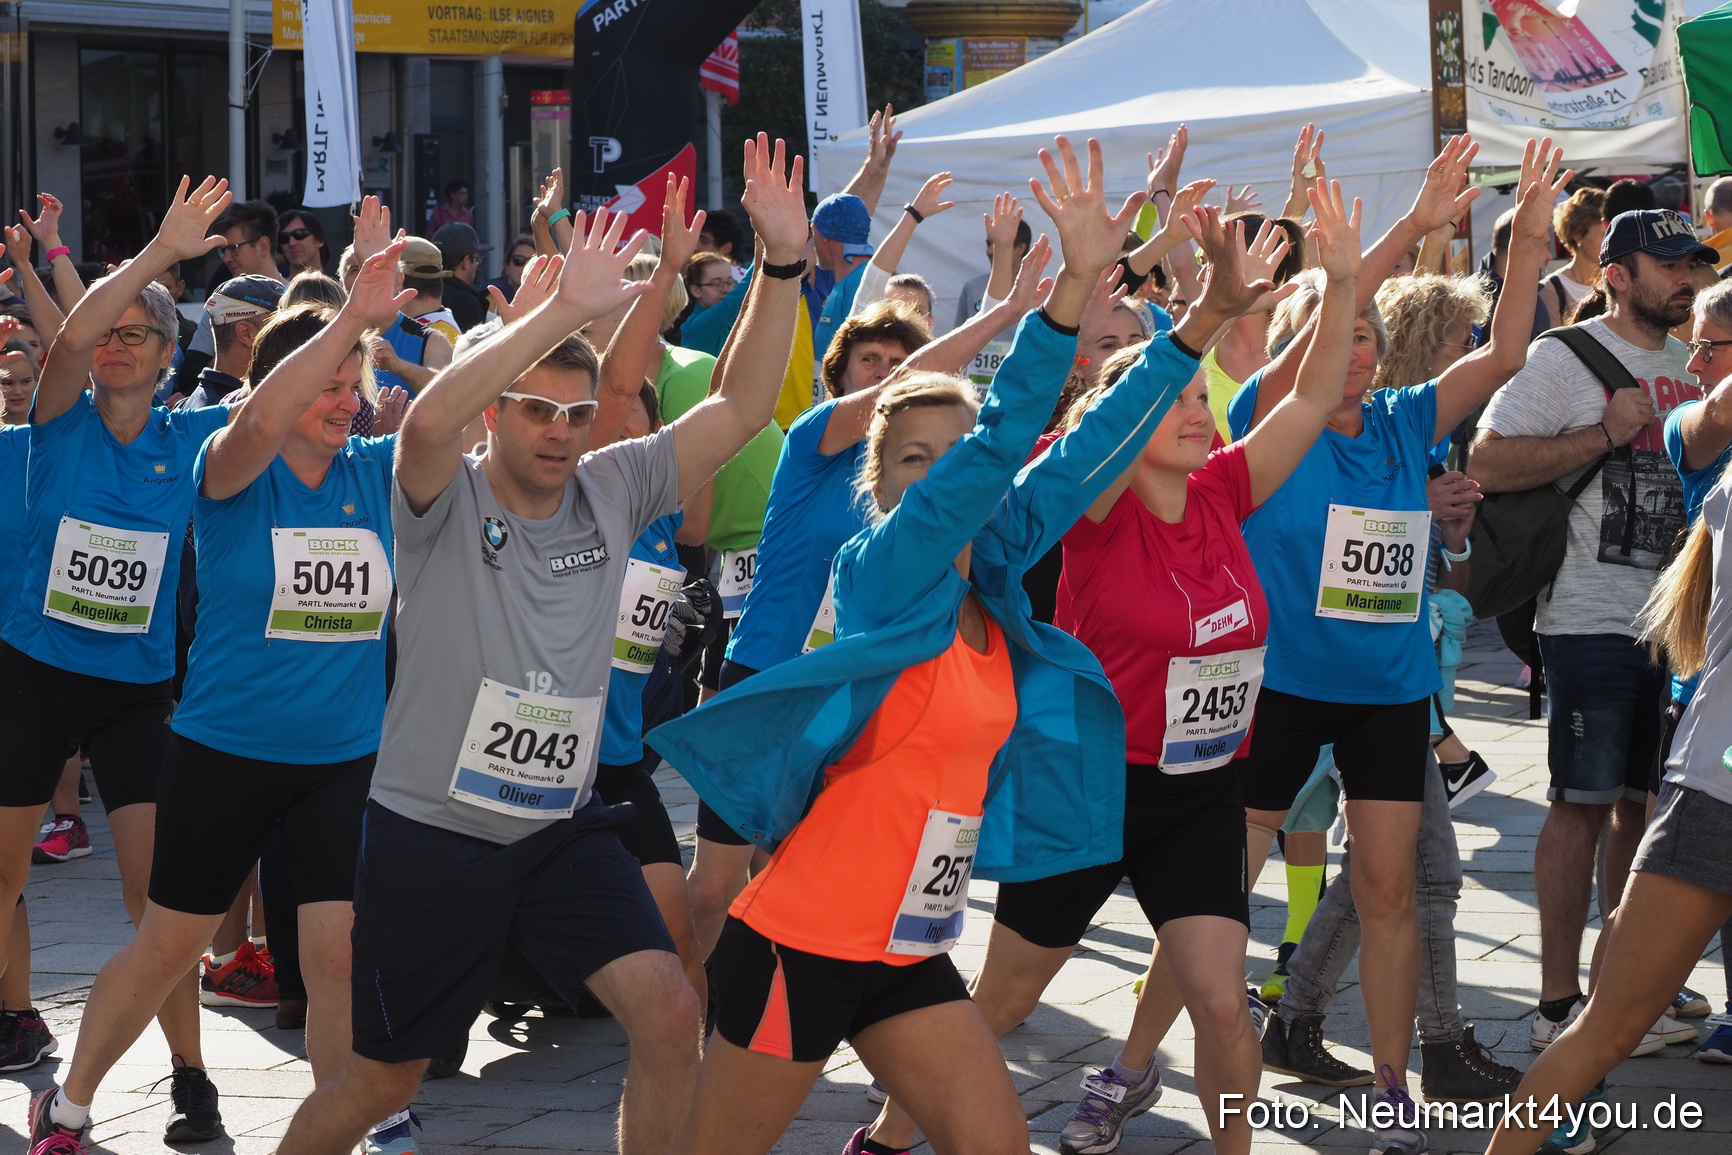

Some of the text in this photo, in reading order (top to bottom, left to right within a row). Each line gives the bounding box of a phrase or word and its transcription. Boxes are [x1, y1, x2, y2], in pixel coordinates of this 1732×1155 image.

[427, 6, 555, 23] VORTRAG: ILSE AIGNER
[1604, 88, 1627, 105] 21
[975, 353, 1005, 369] 518
[143, 475, 179, 486] Angelika
[1364, 520, 1407, 533] BOCK
[89, 534, 138, 551] BOCK
[308, 539, 360, 551] BOCK
[550, 543, 608, 572] BOCK
[1329, 539, 1415, 576] S 5038
[56, 549, 147, 591] S 5039
[292, 561, 370, 596] 5041
[1347, 577, 1400, 589] PARTL Neumarkt
[71, 585, 128, 602] PARTL Neumarkt
[1345, 593, 1402, 611] Marianne
[71, 600, 129, 622] Angelika
[298, 600, 357, 609] PARTL Neumarkt
[304, 615, 353, 630] Christa
[1211, 613, 1233, 633] DEHN
[631, 630, 649, 641] PARTL
[1199, 660, 1240, 677] BOCK
[1182, 681, 1249, 724] 2453
[516, 702, 573, 723] BOCK
[1186, 723, 1232, 736] PARTL Neumarkt
[470, 721, 580, 771] C 2043
[1194, 740, 1226, 758] Nicole
[488, 762, 555, 783] PARTL Neumarkt
[498, 783, 544, 806] Oliver
[922, 854, 973, 896] 257
[923, 902, 942, 911] PARTL
